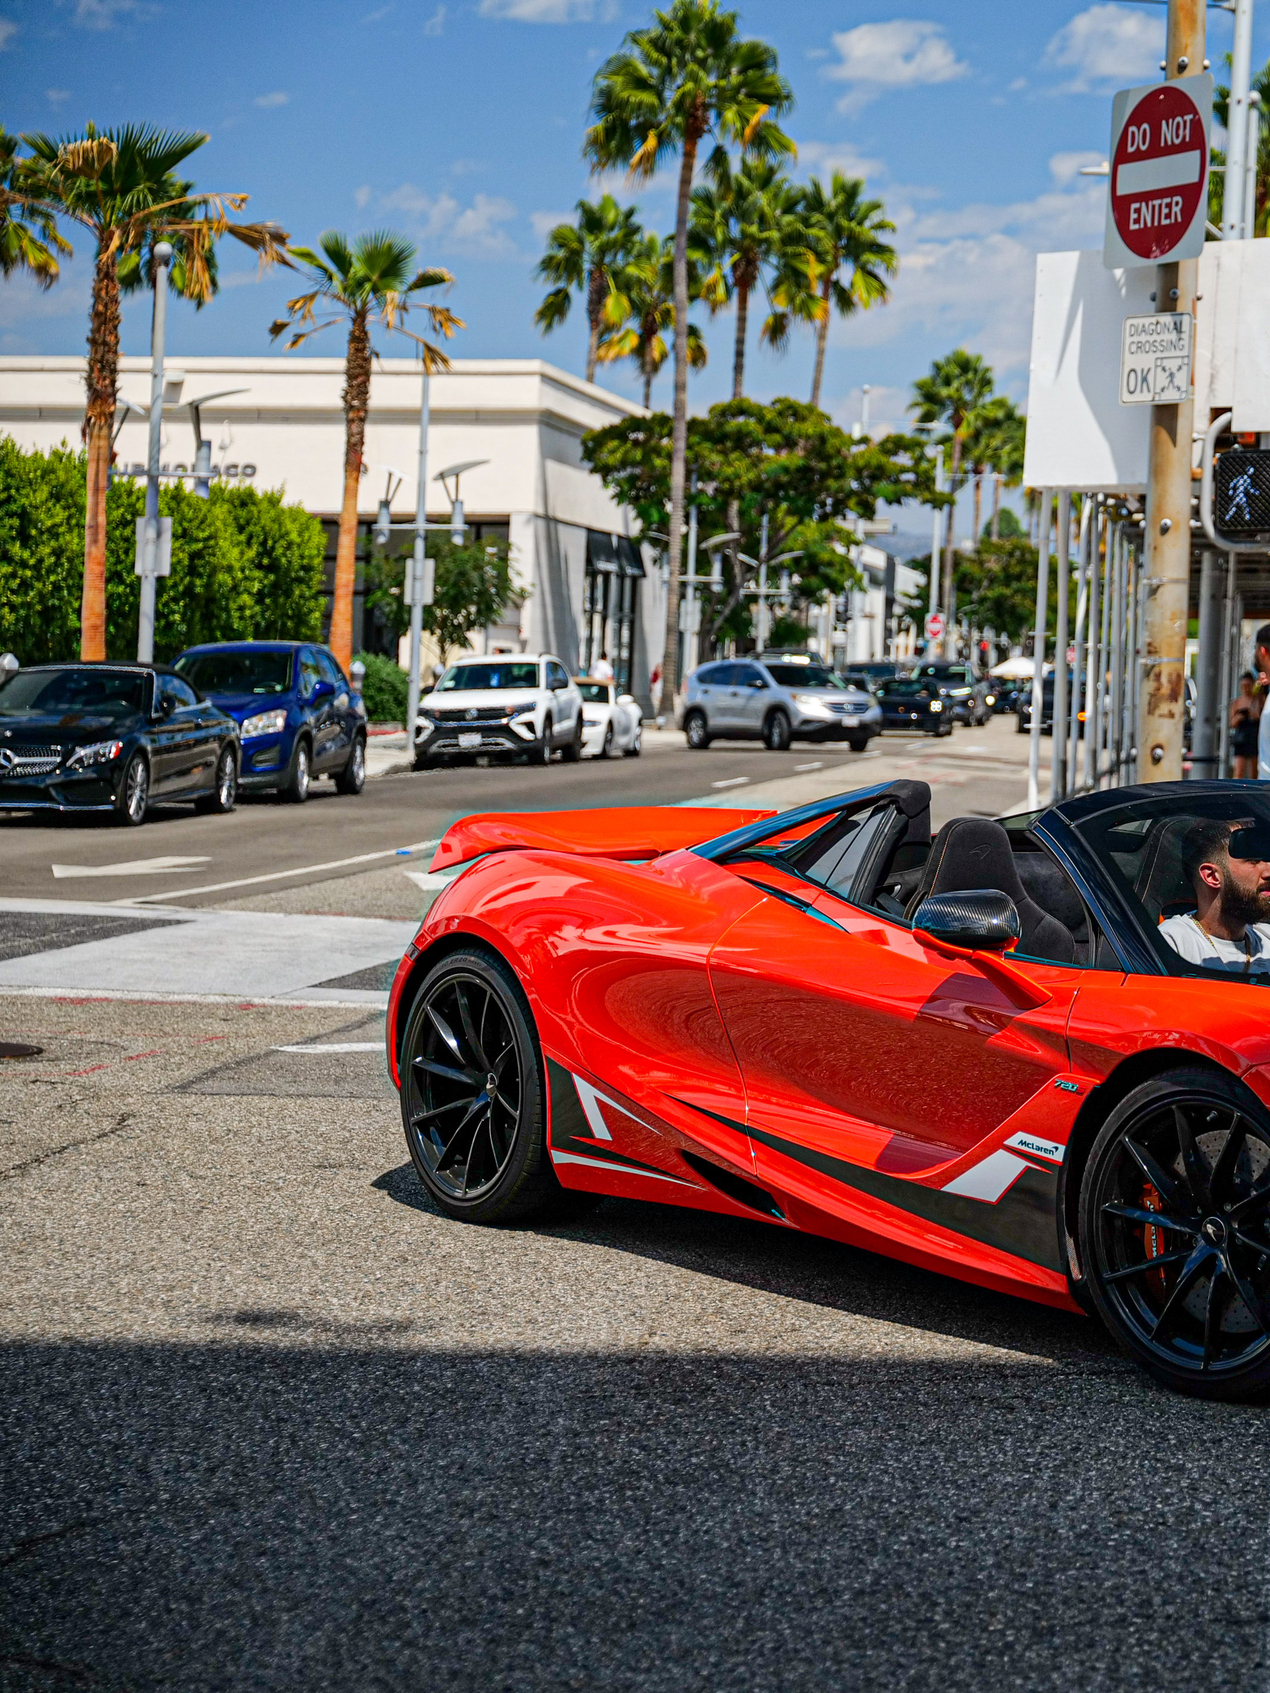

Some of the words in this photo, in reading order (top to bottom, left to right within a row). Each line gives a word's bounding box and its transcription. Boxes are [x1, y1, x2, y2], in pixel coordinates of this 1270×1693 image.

[1127, 122, 1150, 153] DO
[1160, 113, 1194, 147] NOT
[1129, 195, 1183, 230] ENTER
[1128, 320, 1186, 337] DIAGONAL
[1128, 337, 1185, 355] CROSSING
[1126, 367, 1151, 395] OK
[1054, 1079, 1087, 1096] 720S
[1017, 1139, 1056, 1156] McLaren
[1149, 1204, 1158, 1258] McLan
